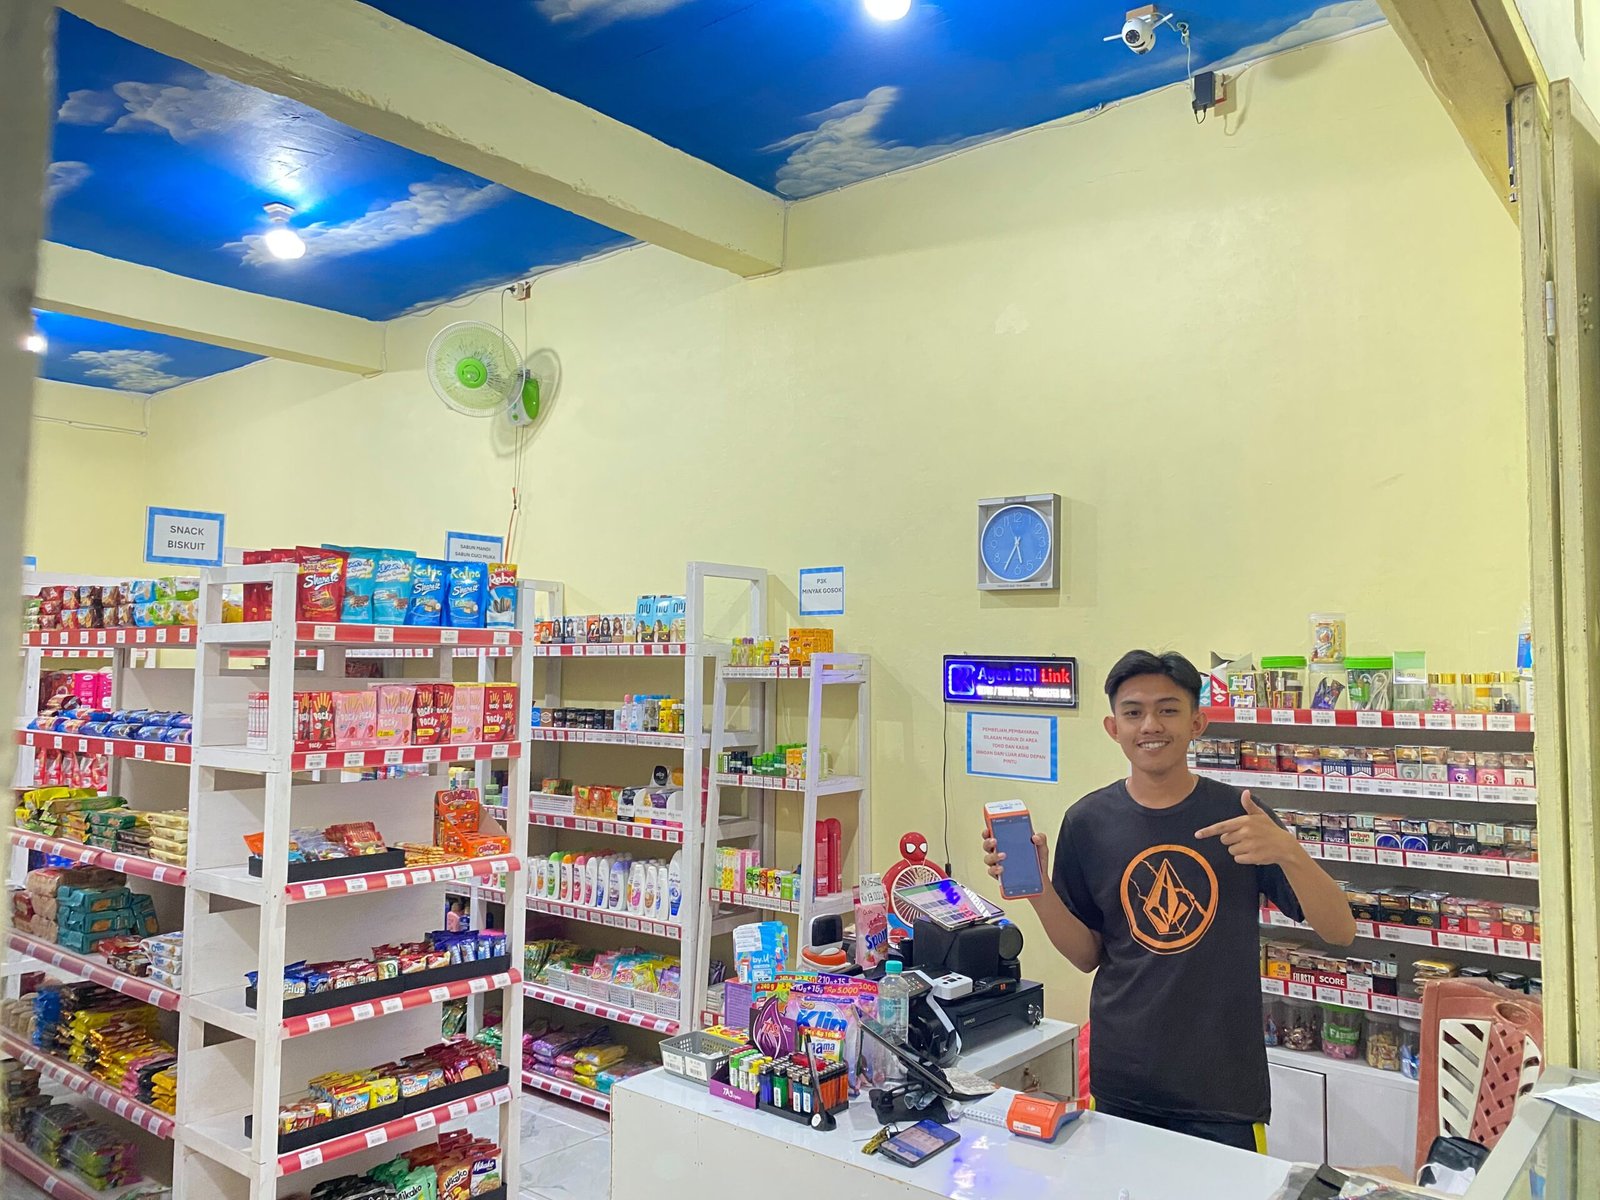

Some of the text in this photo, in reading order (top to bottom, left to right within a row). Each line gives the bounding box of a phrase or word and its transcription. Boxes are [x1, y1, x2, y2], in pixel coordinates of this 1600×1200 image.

[170, 525, 205, 536] SNACK
[167, 540, 206, 551] BISKUIT
[450, 566, 481, 579] Kalpa
[489, 573, 515, 588] Rebo
[977, 667, 1071, 684] Agen BRI Link
[1319, 974, 1345, 986] SCORE
[283, 984, 305, 994] Pilus
[837, 985, 858, 995] 5.000
[796, 1009, 848, 1032] Klin
[443, 1169, 468, 1190] Mikako
